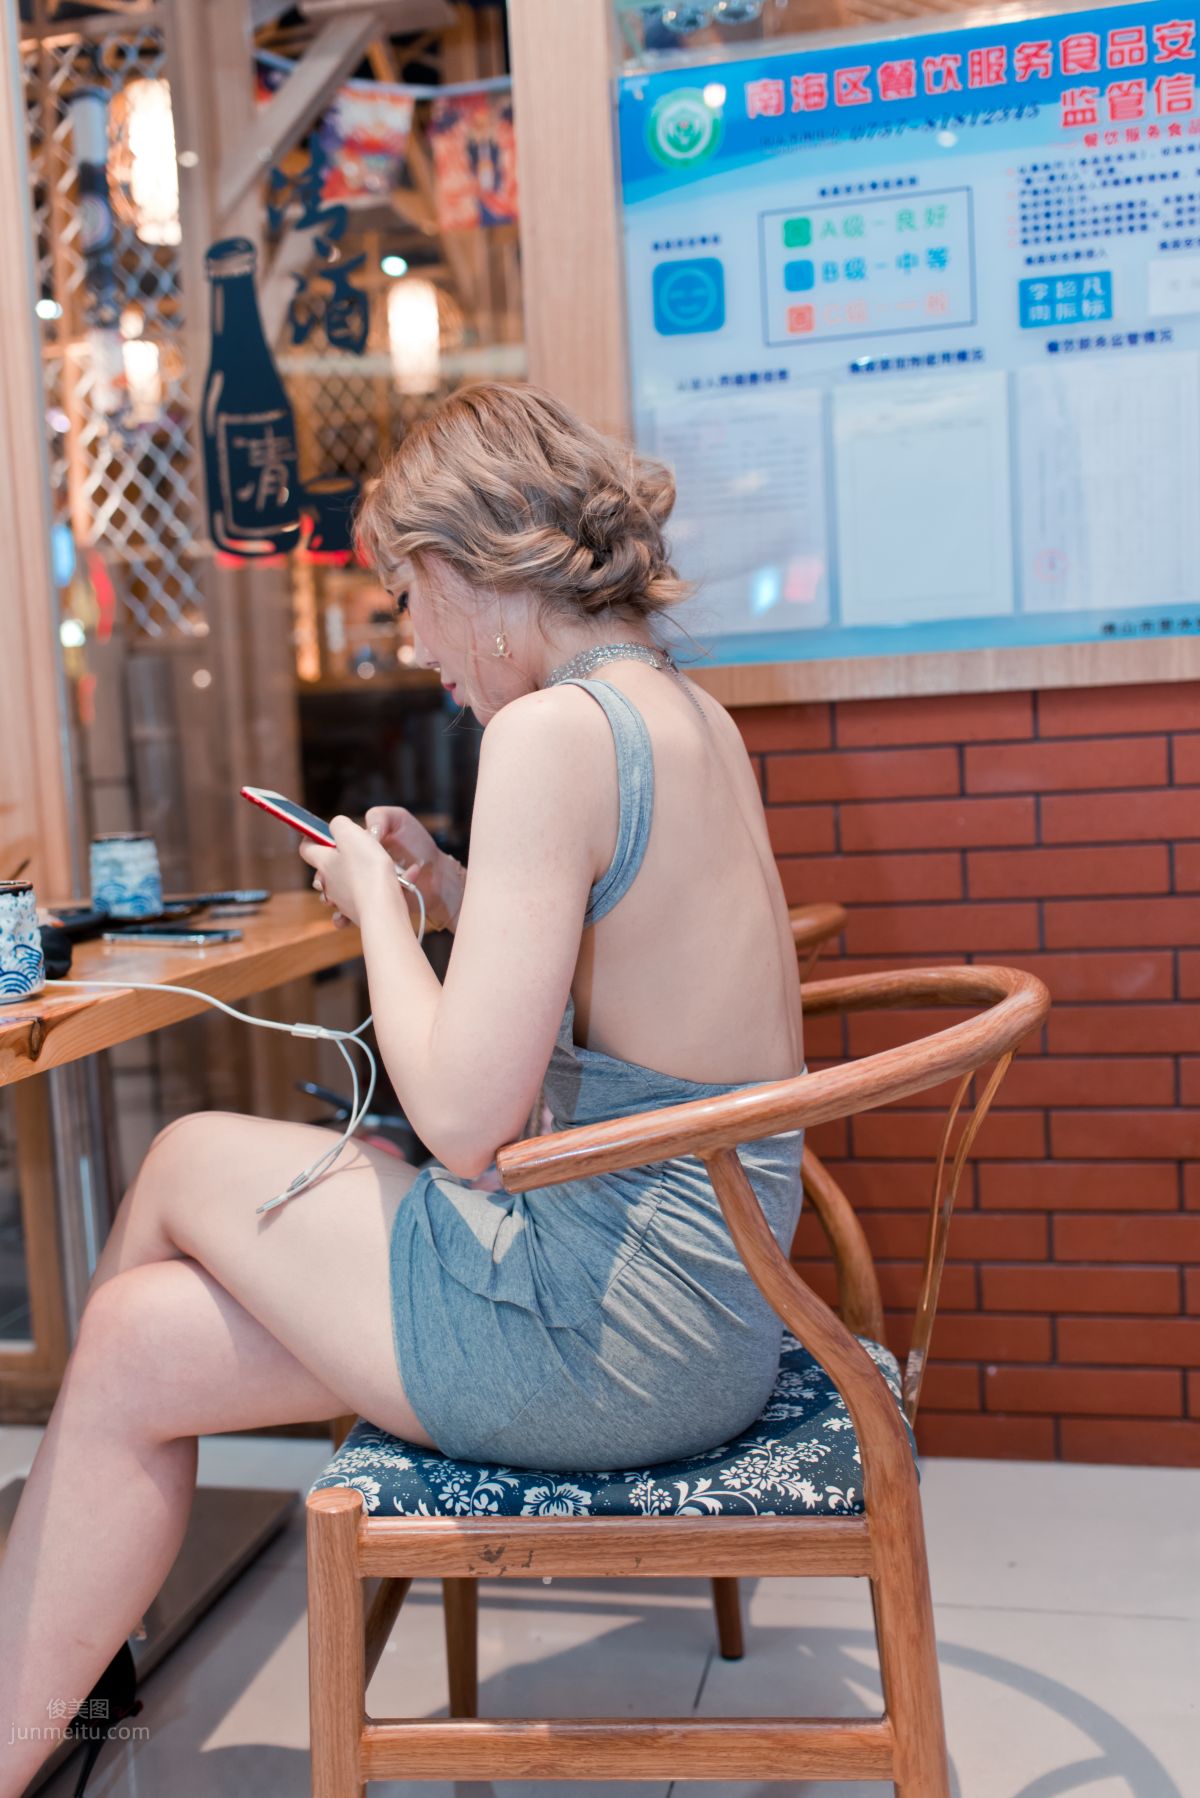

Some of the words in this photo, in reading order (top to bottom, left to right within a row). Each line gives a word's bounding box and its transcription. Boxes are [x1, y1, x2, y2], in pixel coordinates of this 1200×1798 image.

[743, 18, 1196, 120] 南海区餐饮服务食品安
[1059, 72, 1196, 128] 监管信
